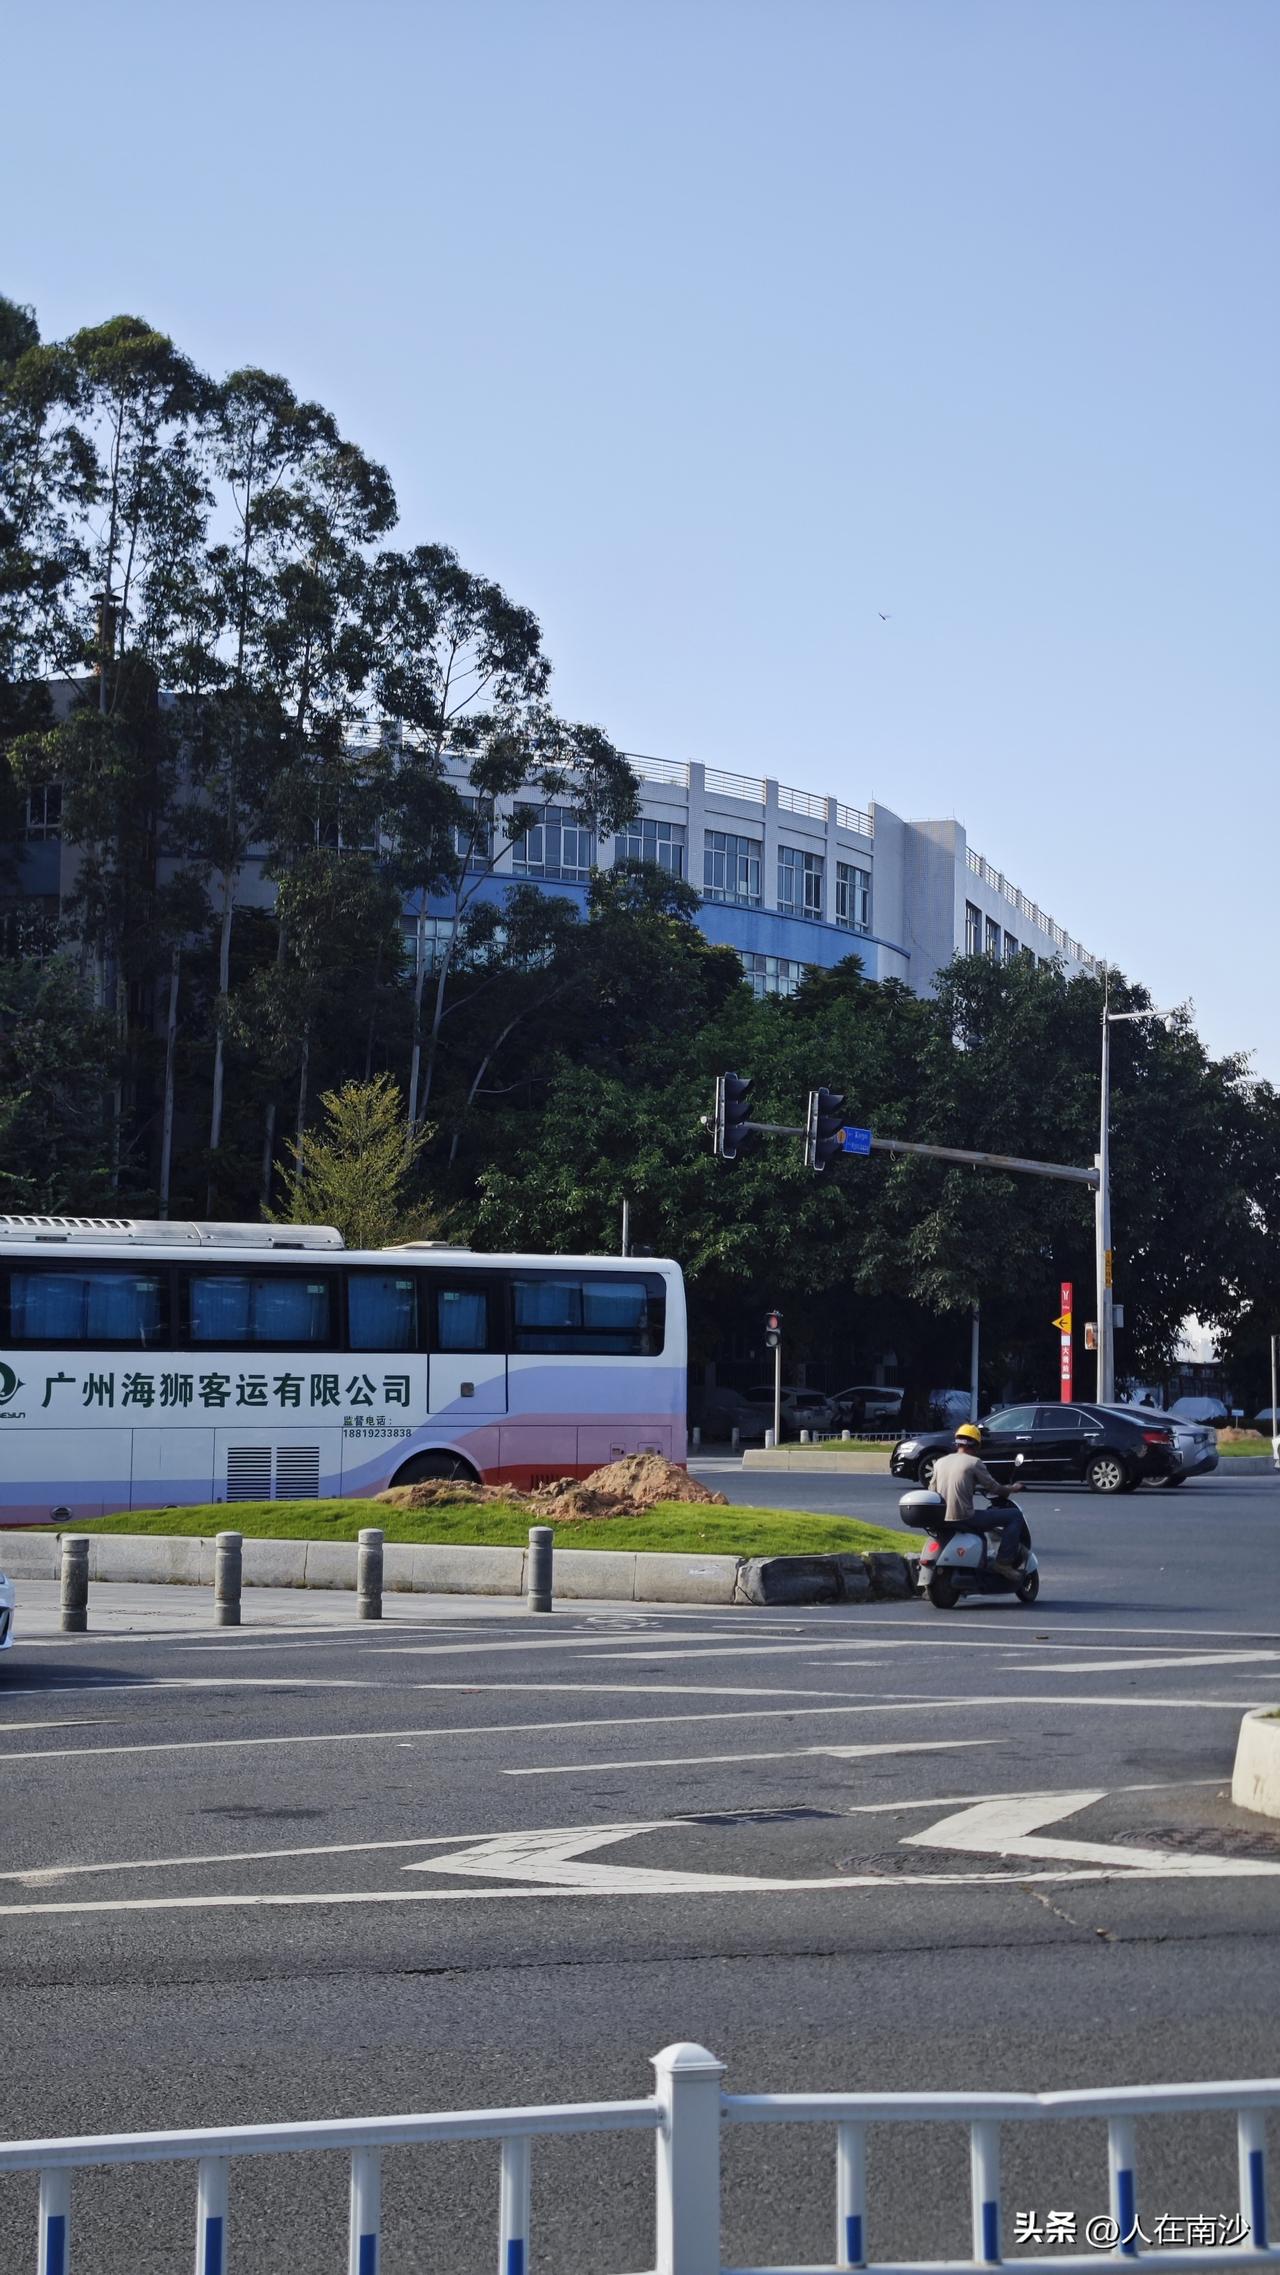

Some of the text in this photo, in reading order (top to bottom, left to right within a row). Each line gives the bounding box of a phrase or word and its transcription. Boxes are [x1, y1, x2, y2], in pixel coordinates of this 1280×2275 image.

[41, 1372, 411, 1408] 广州海狮客运有限公司
[343, 1428, 412, 1438] 18819233838
